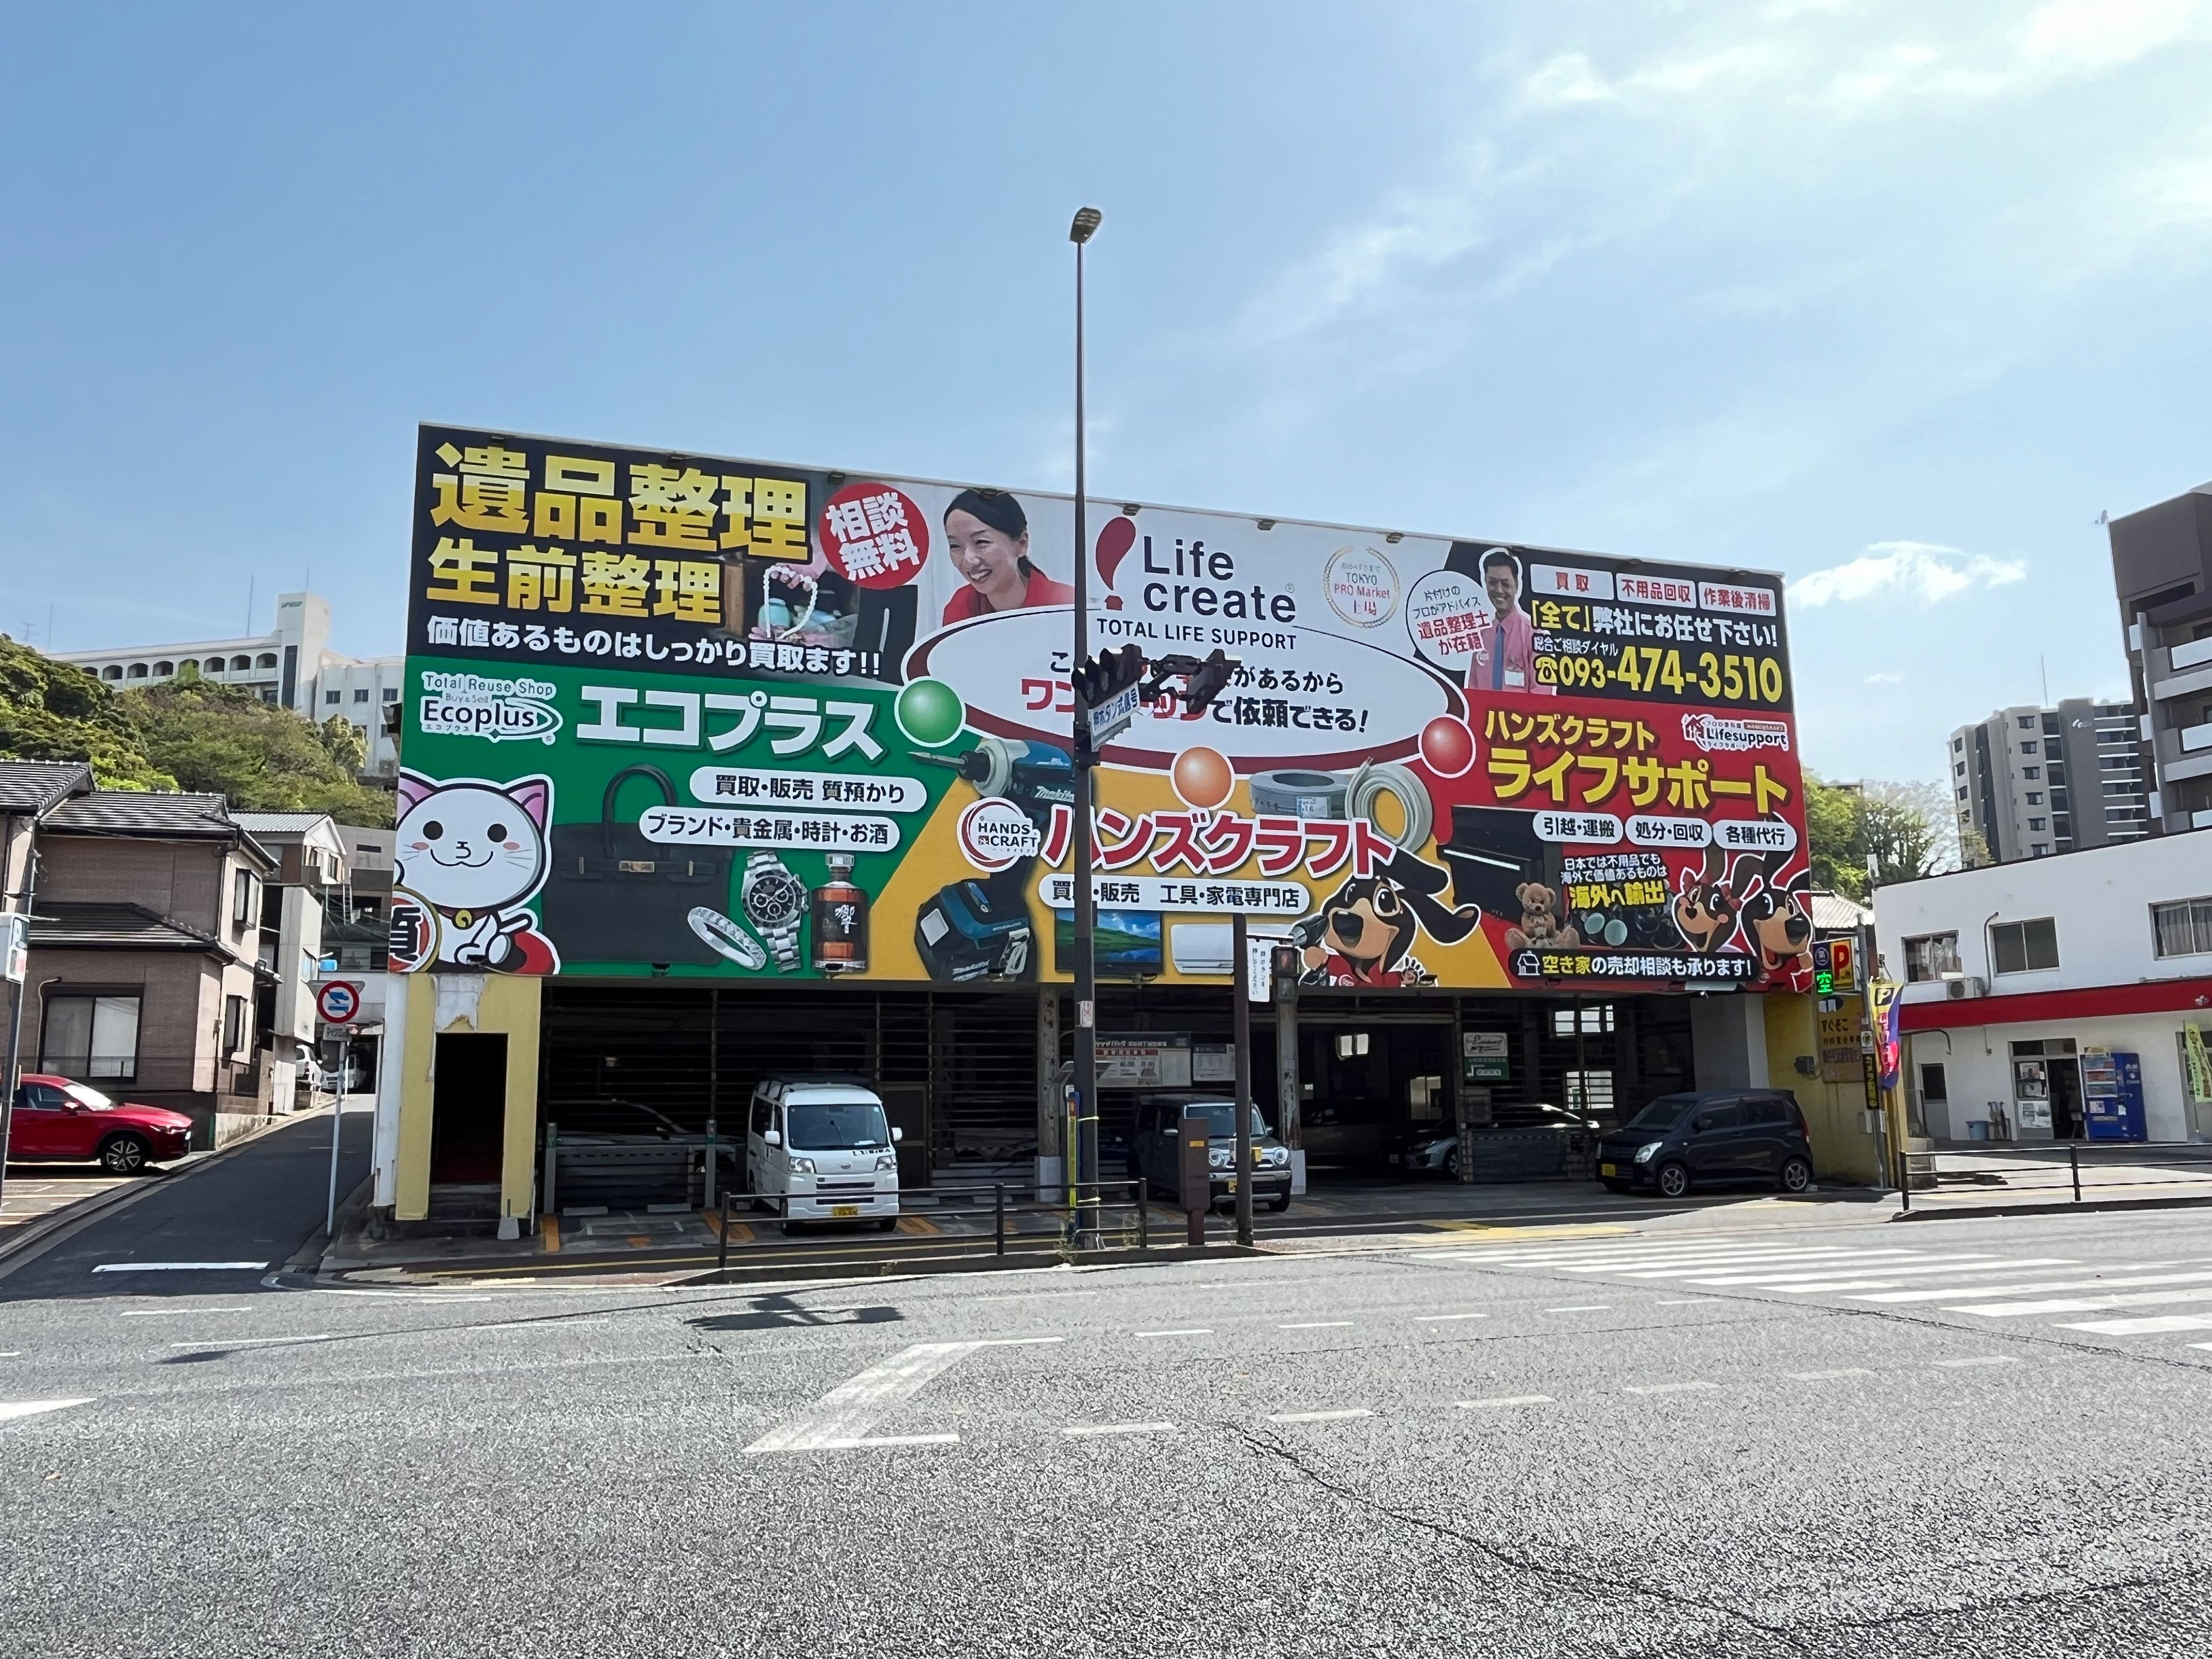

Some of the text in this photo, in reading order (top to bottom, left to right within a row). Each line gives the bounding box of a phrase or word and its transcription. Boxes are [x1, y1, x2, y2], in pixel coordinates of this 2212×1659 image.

[431, 442, 809, 560] 遺品整理
[825, 491, 908, 541] 相談
[839, 532, 920, 582] 無料
[1143, 536, 1234, 581] Life
[426, 537, 721, 624] 生前整理
[1335, 584, 1390, 599] PRO Market
[1346, 572, 1377, 585] TOKYO
[1556, 572, 1589, 592] 買取
[1622, 579, 1691, 603] 不用品回収
[1143, 580, 1296, 623] create
[1424, 586, 1460, 601] 片付けの
[1412, 597, 1481, 619] プロがアドバイス
[1097, 618, 1297, 650] TOTAL LIFE SUPPORT
[1417, 610, 1490, 639] 遺品整理士
[428, 616, 881, 677] 価値あるものはしっかり買取ます!!
[1438, 632, 1483, 656] が在籍
[426, 675, 553, 696] Total Reuse Shop
[1559, 646, 1783, 703] 093-474-3510
[424, 699, 534, 733] Ecoplus
[577, 685, 883, 761] エコプラス
[1486, 710, 1656, 750] ハンズクラフト
[1706, 727, 1787, 746] Lifesupport
[716, 774, 906, 804] 買取・販売 質預かり
[1488, 748, 1787, 813] ライフサポート
[648, 813, 889, 845] ブランド・貴金属・時計・お酒
[978, 823, 1031, 835] HANDS
[1544, 817, 1615, 838] 引越・運搬
[1636, 821, 1703, 842] 処分・回収
[1726, 825, 1785, 846] 各種代行
[990, 835, 1038, 848] CRAFT
[1565, 853, 1661, 870] 日本では不用品でも
[1560, 865, 1668, 885] 海外で価値あるものは
[1052, 880, 1300, 908] 買・販売 工具・家電専門店
[1569, 880, 1665, 910] 海外へ輸出
[1543, 955, 1751, 978] 空き家の売却相談も承ります!
[1834, 945, 1849, 980] P
[1816, 972, 1833, 993] 空
[1877, 988, 1892, 1005] P
